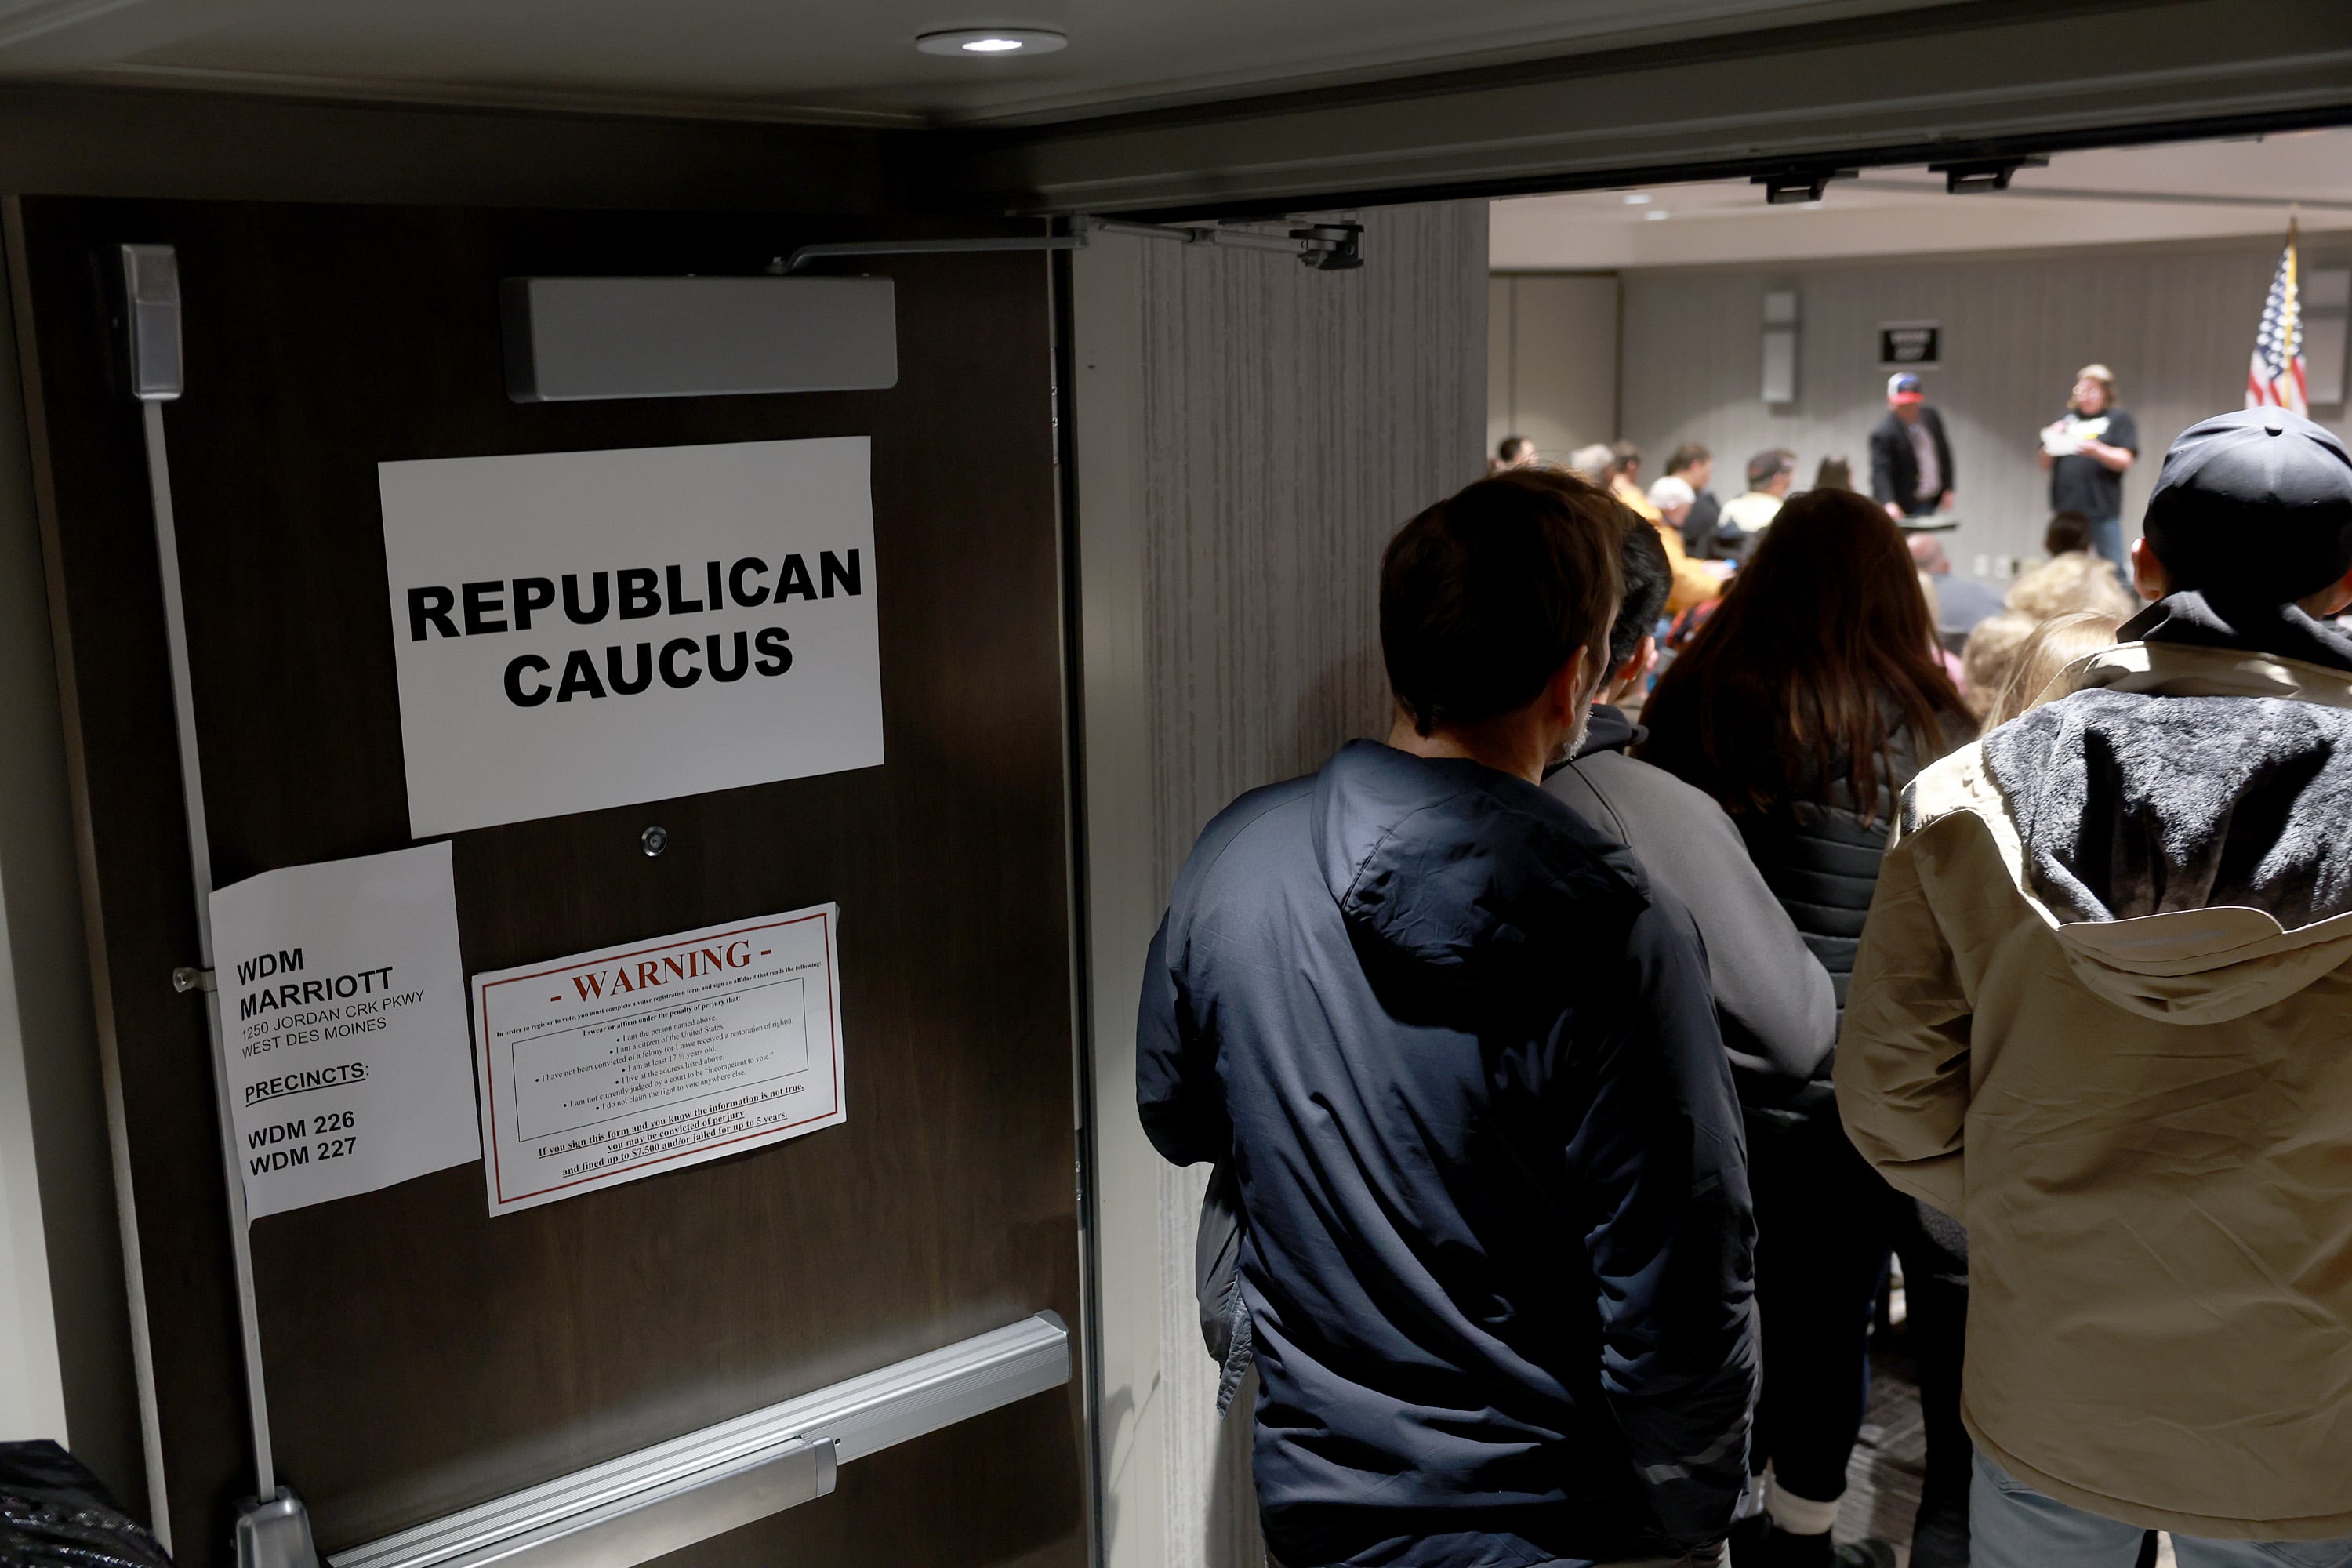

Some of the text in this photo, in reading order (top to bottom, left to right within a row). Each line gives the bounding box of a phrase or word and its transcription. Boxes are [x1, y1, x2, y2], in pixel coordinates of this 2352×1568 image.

[408, 549, 861, 641] REPUBLICAN
[504, 627, 792, 707] CAUCUS
[237, 948, 303, 985] WDM
[572, 939, 751, 1002] WARNING
[241, 967, 393, 1021] MARRIOTT
[243, 989, 424, 1041] 1250 JORDAN CRK PKWY
[531, 1021, 554, 1030] register
[577, 1012, 589, 1021] you
[590, 1008, 604, 1017] must
[605, 1003, 631, 1013] complete
[653, 990, 686, 1002] registration
[733, 974, 757, 984] affidavit
[769, 967, 785, 976] reads
[616, 1019, 637, 1029] affirm
[638, 1014, 657, 1024] under
[670, 1007, 691, 1018] penalty
[701, 1000, 724, 1011] perjury
[242, 1017, 386, 1058] WEST DES MOINES
[637, 1039, 659, 1049] citizen
[660, 1034, 669, 1044] of
[681, 1027, 703, 1039] United
[651, 1025, 673, 1037] person
[673, 1018, 695, 1030] named
[542, 1074, 545, 1083] I
[546, 1073, 563, 1081] have
[576, 1065, 593, 1073] been
[594, 1054, 626, 1069] convicted
[628, 1053, 636, 1062] of
[642, 1049, 663, 1058] felony
[664, 1045, 674, 1054] (or
[680, 1041, 695, 1050] have
[696, 1033, 724, 1046] received
[730, 1025, 764, 1038] restoration
[764, 1022, 772, 1030] of
[626, 1075, 639, 1083] live
[648, 1069, 659, 1078] the
[659, 1065, 684, 1076] address
[684, 1058, 702, 1069] listed
[652, 1057, 667, 1066] least
[669, 1054, 677, 1062] 17
[686, 1050, 703, 1060] years
[246, 1063, 368, 1106] PRECINCTS:
[586, 1095, 598, 1104] not
[599, 1087, 629, 1101] currently
[630, 1080, 653, 1094] judged
[654, 1079, 662, 1088] by
[669, 1073, 686, 1083] court
[606, 1101, 615, 1109] do
[616, 1098, 628, 1107] not
[629, 1094, 647, 1103] claim
[660, 1086, 676, 1096] right
[700, 1073, 731, 1086] anywhere
[249, 1111, 354, 1149] WDM 226
[539, 1146, 547, 1156] If
[548, 1144, 566, 1156] you
[568, 1139, 587, 1152] sign
[589, 1133, 605, 1144] this
[608, 1128, 630, 1139] form
[631, 1120, 648, 1133] and
[650, 1118, 666, 1131] you
[668, 1112, 691, 1123] know
[694, 1108, 708, 1117] the
[709, 1095, 759, 1112] information
[760, 1091, 768, 1100] is
[770, 1088, 783, 1098] not
[608, 1142, 624, 1154] you
[626, 1137, 644, 1149] may
[659, 1120, 700, 1138] convicted
[702, 1116, 711, 1127] of
[713, 1111, 745, 1127] perjury
[250, 1137, 356, 1175] WDM 227
[562, 1163, 579, 1176] and
[582, 1157, 604, 1171] fined
[607, 1156, 619, 1167] up
[631, 1143, 660, 1160] $7,500
[662, 1137, 691, 1152] and/or
[693, 1128, 717, 1144] jailed
[718, 1126, 731, 1135] for
[733, 1123, 745, 1134] up
[756, 1116, 762, 1125] 5
